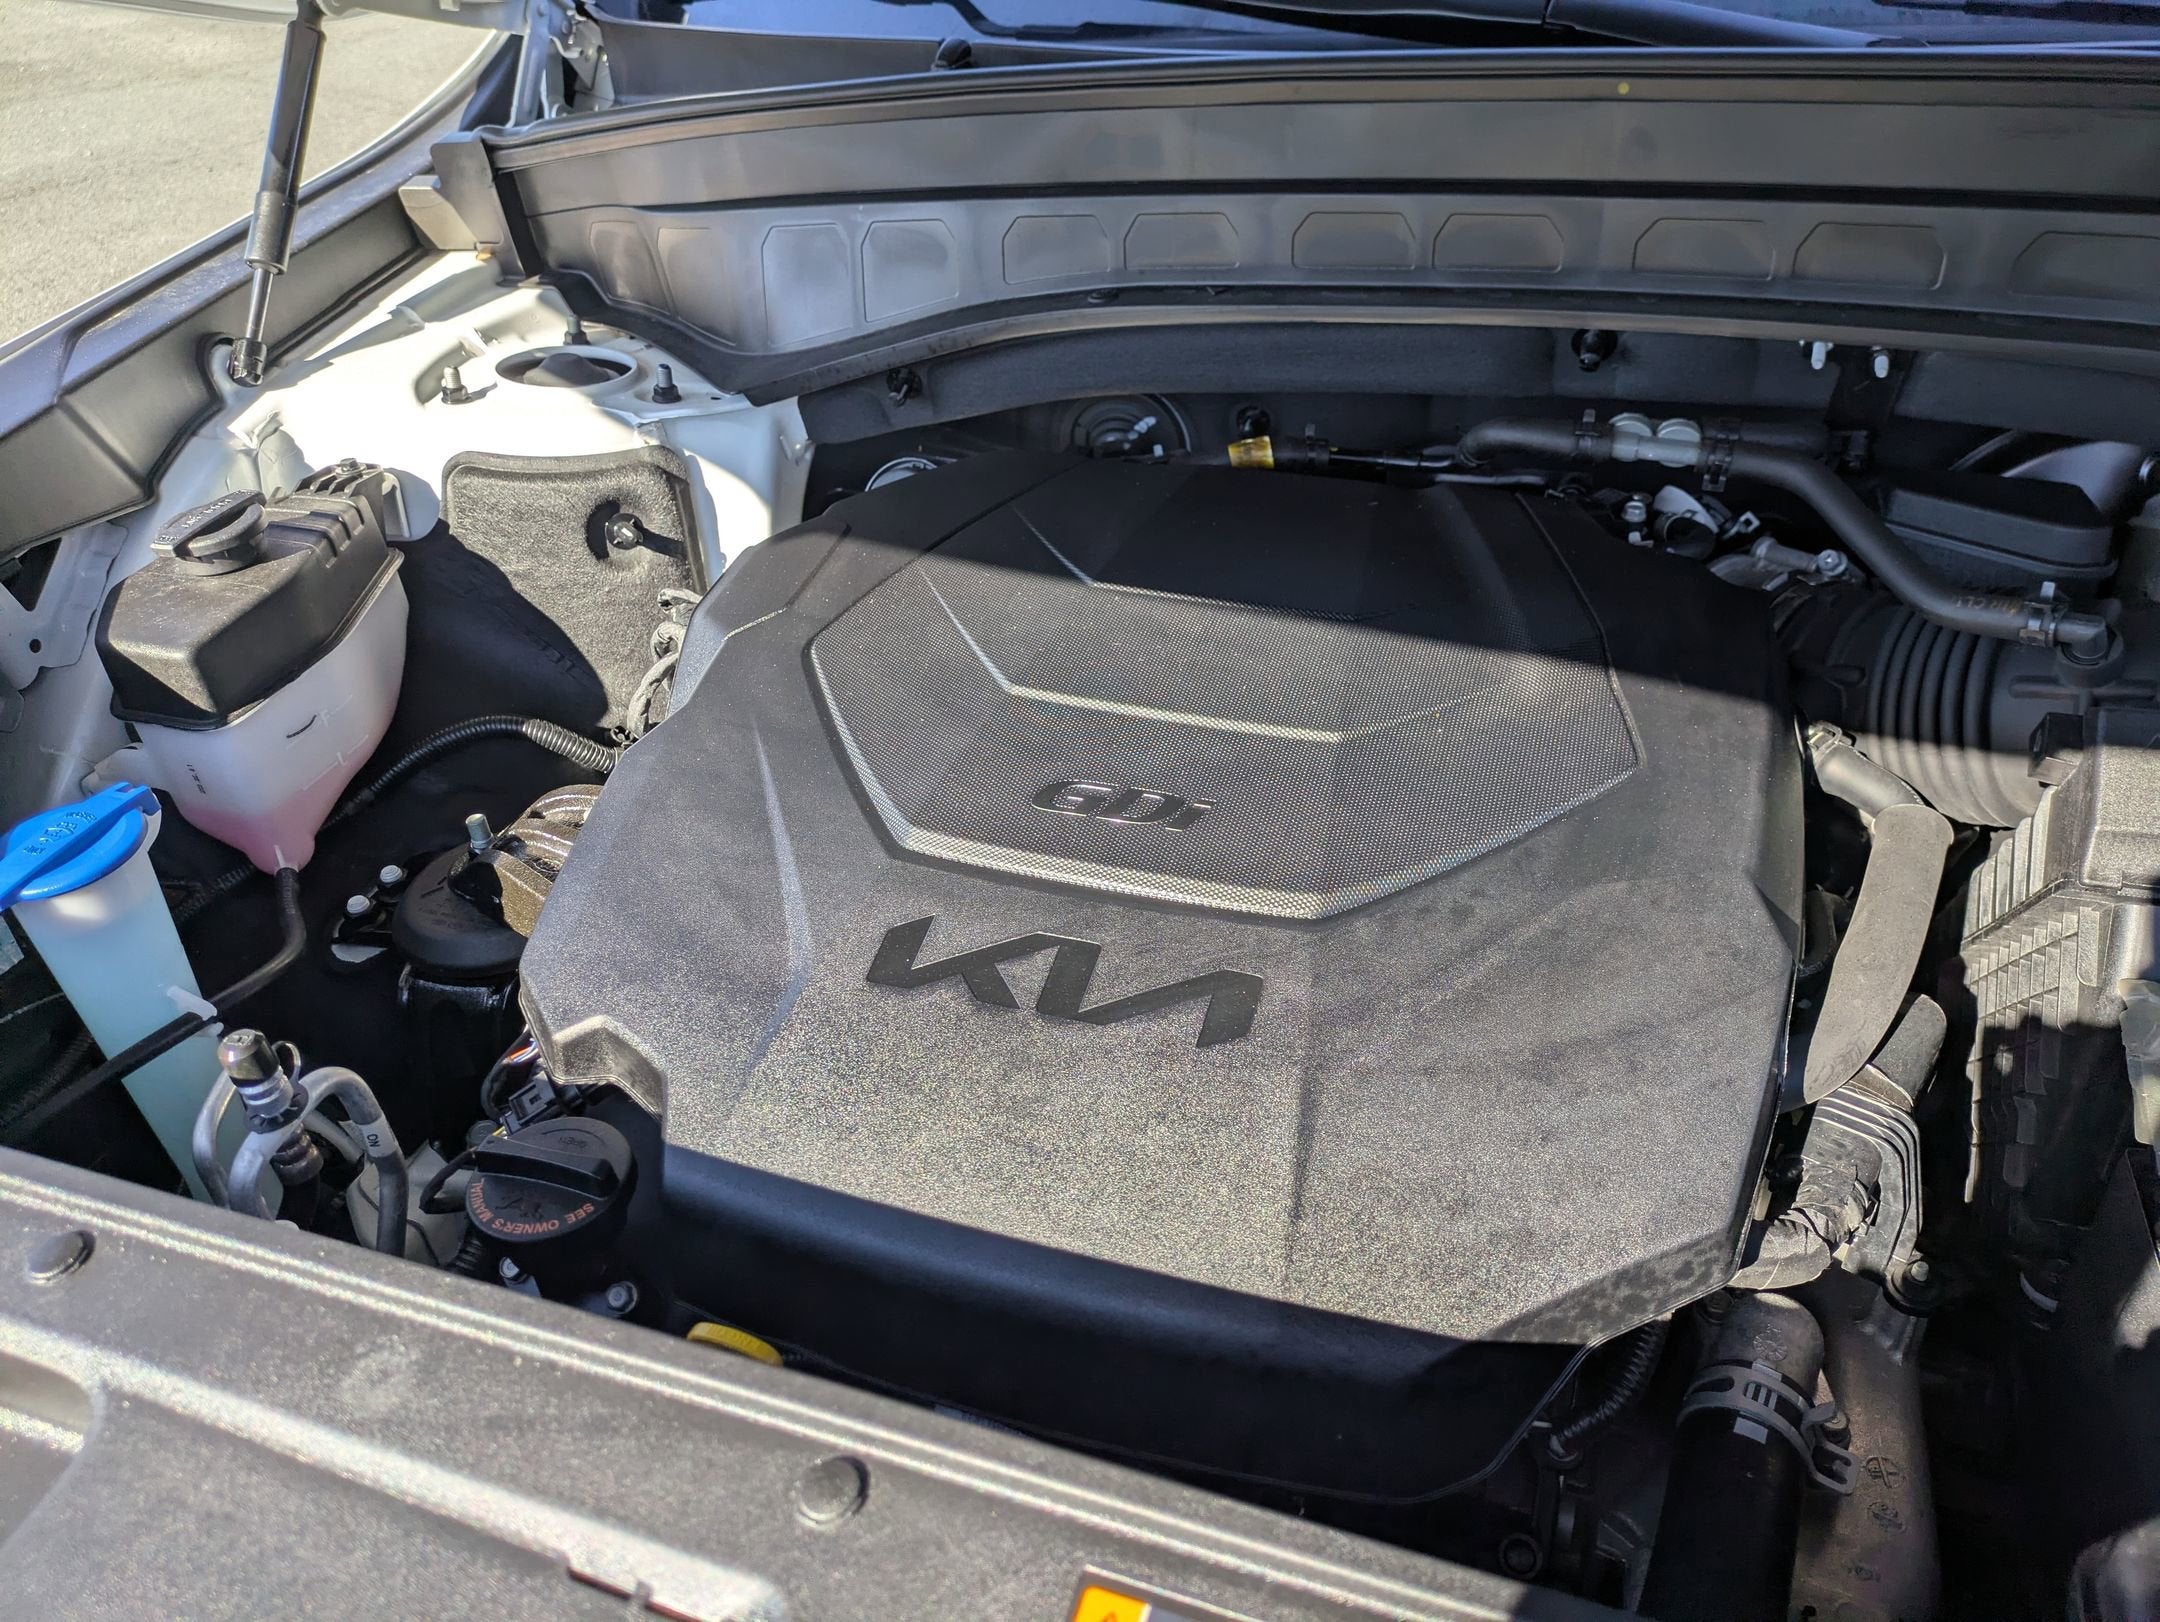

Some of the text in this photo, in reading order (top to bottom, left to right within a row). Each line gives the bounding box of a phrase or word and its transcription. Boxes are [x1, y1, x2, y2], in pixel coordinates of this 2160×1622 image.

[866, 913, 1263, 1048] KIA
[469, 1177, 595, 1234] SEE OWNER'S MANUAL
